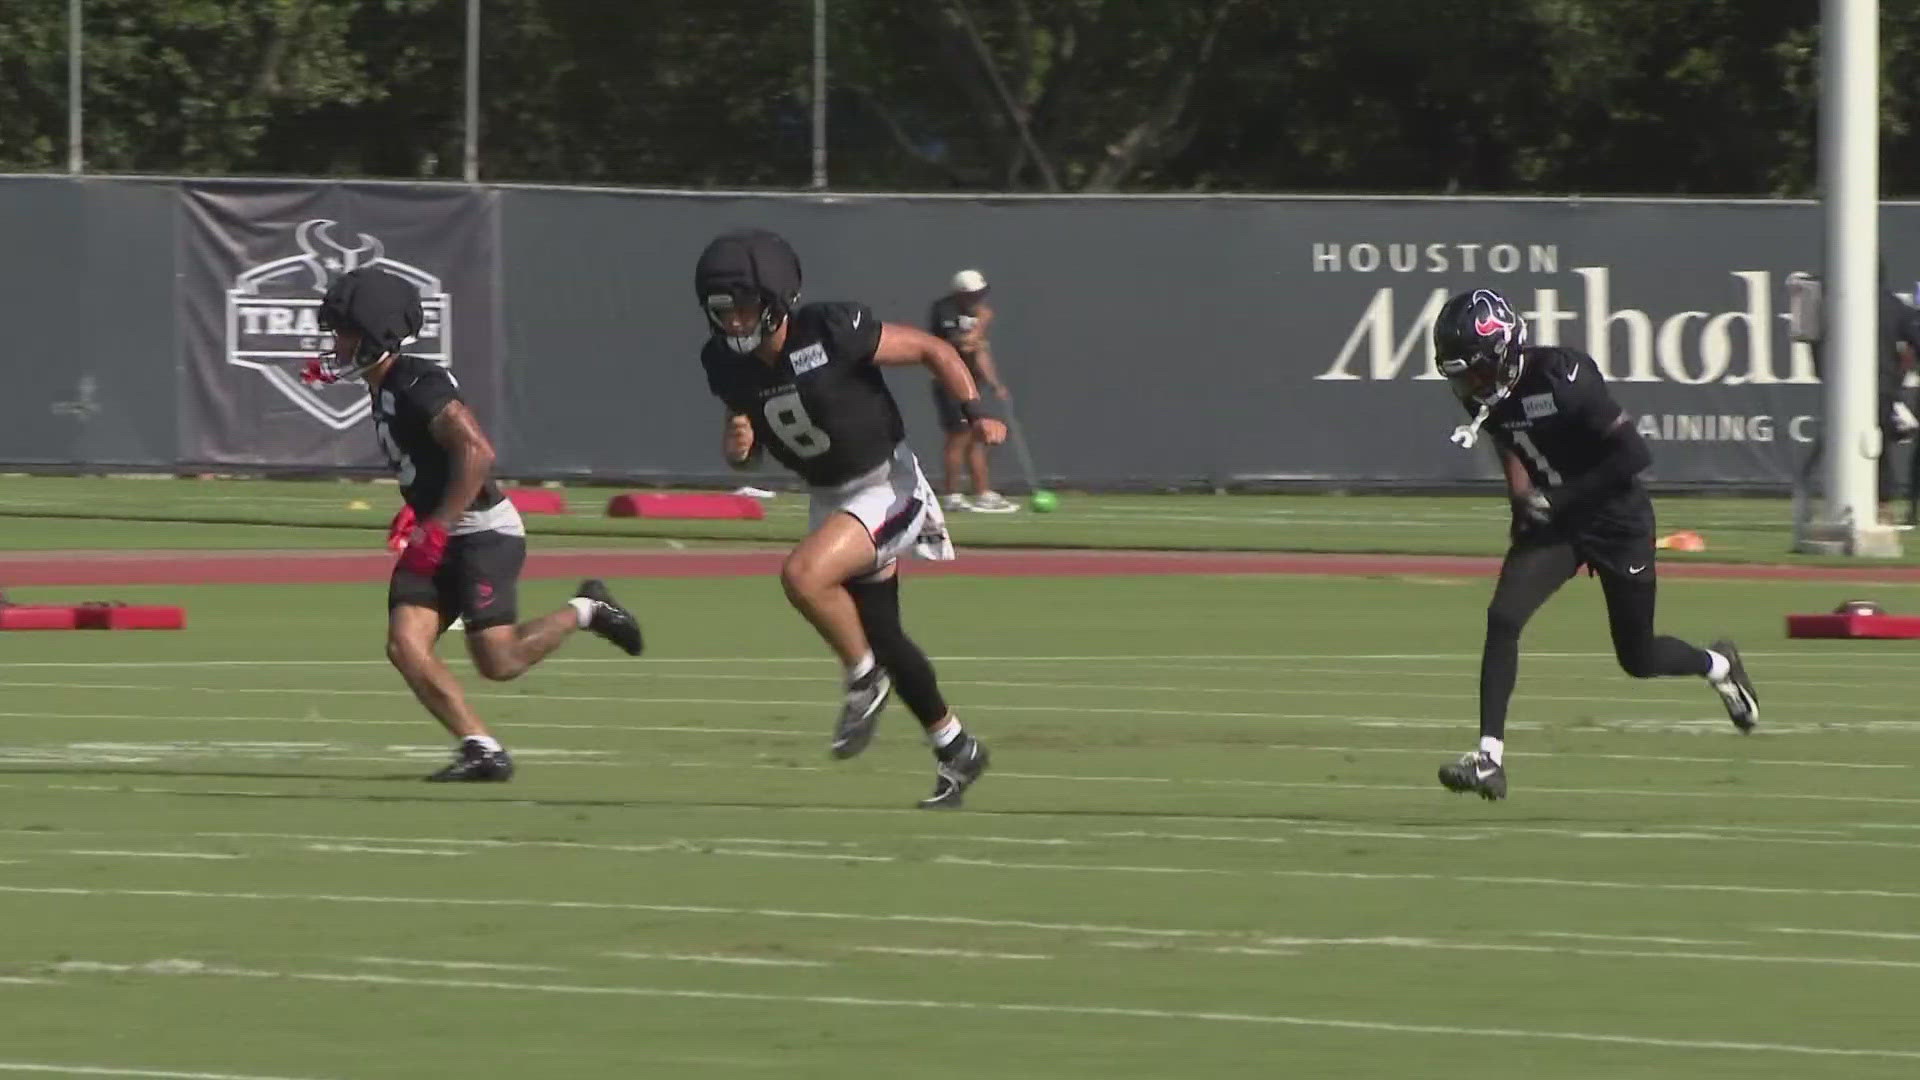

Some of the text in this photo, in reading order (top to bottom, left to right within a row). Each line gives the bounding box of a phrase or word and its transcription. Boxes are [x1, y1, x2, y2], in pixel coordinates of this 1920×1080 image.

[1312, 243, 1558, 273] HOUSTON
[764, 391, 831, 458] 8
[1636, 414, 1774, 442] AINING
[1512, 431, 1562, 486] 1
